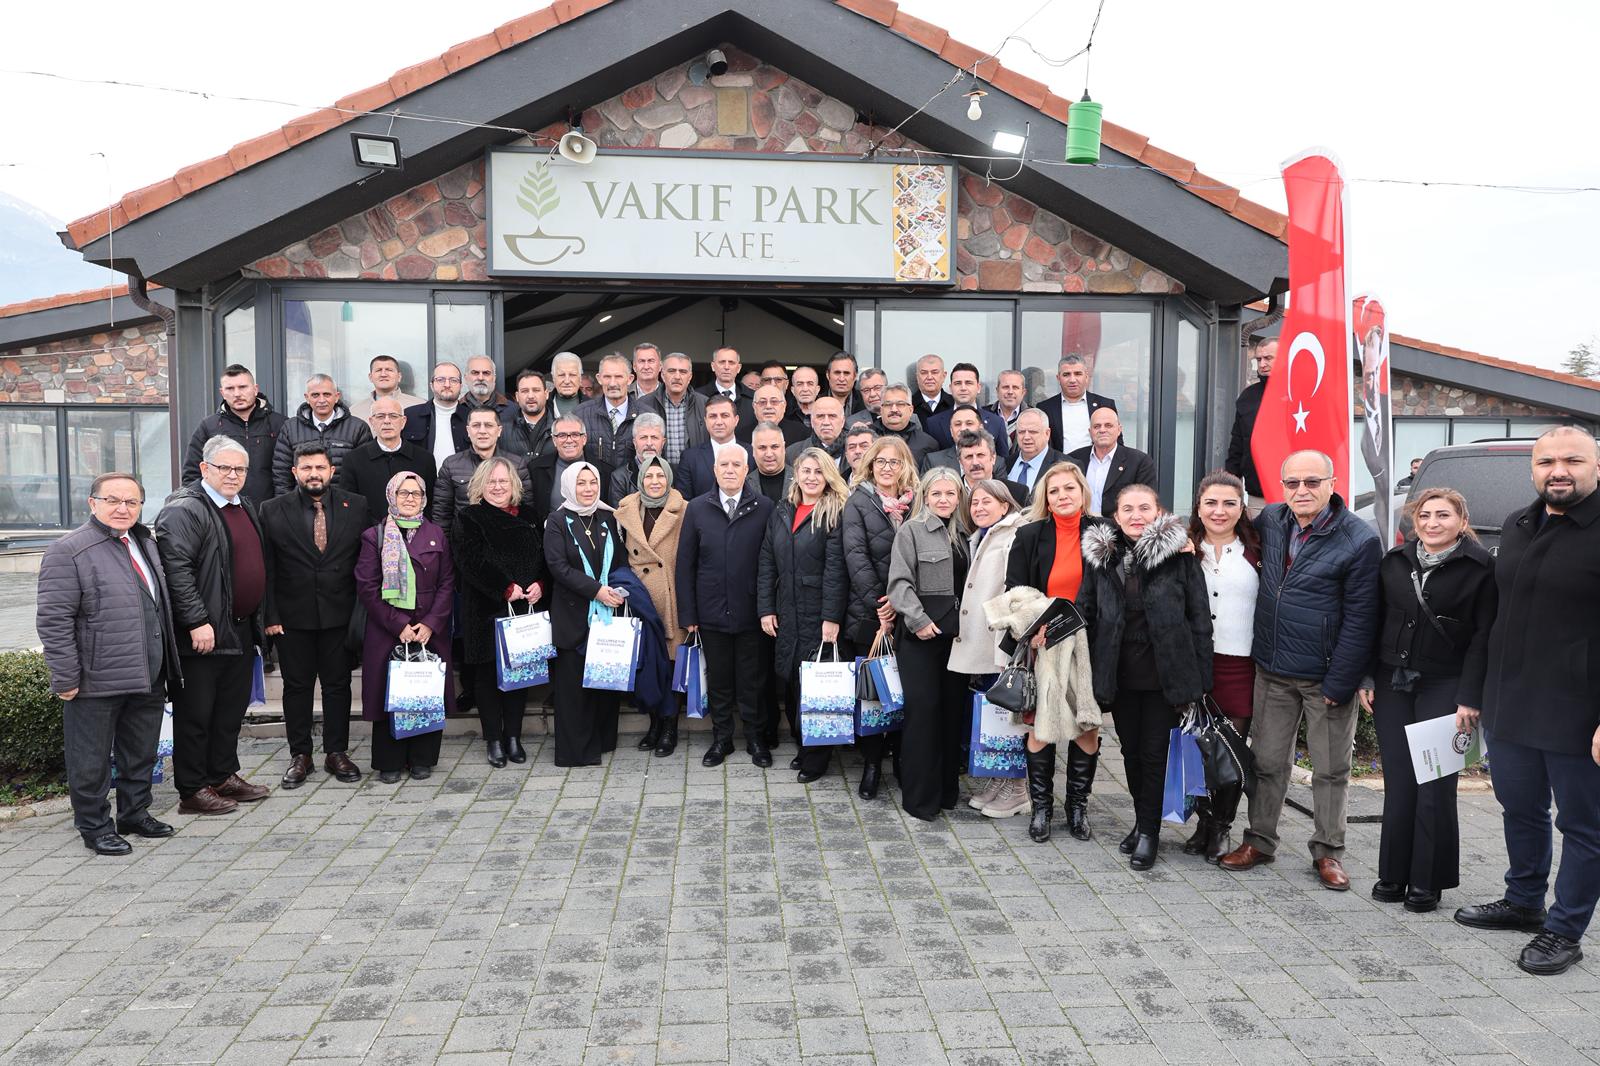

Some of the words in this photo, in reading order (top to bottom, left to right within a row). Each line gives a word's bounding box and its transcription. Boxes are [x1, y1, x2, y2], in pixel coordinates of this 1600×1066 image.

[581, 181, 732, 221] VAKIF
[751, 185, 884, 226] PARK
[694, 231, 774, 259] KAFE
